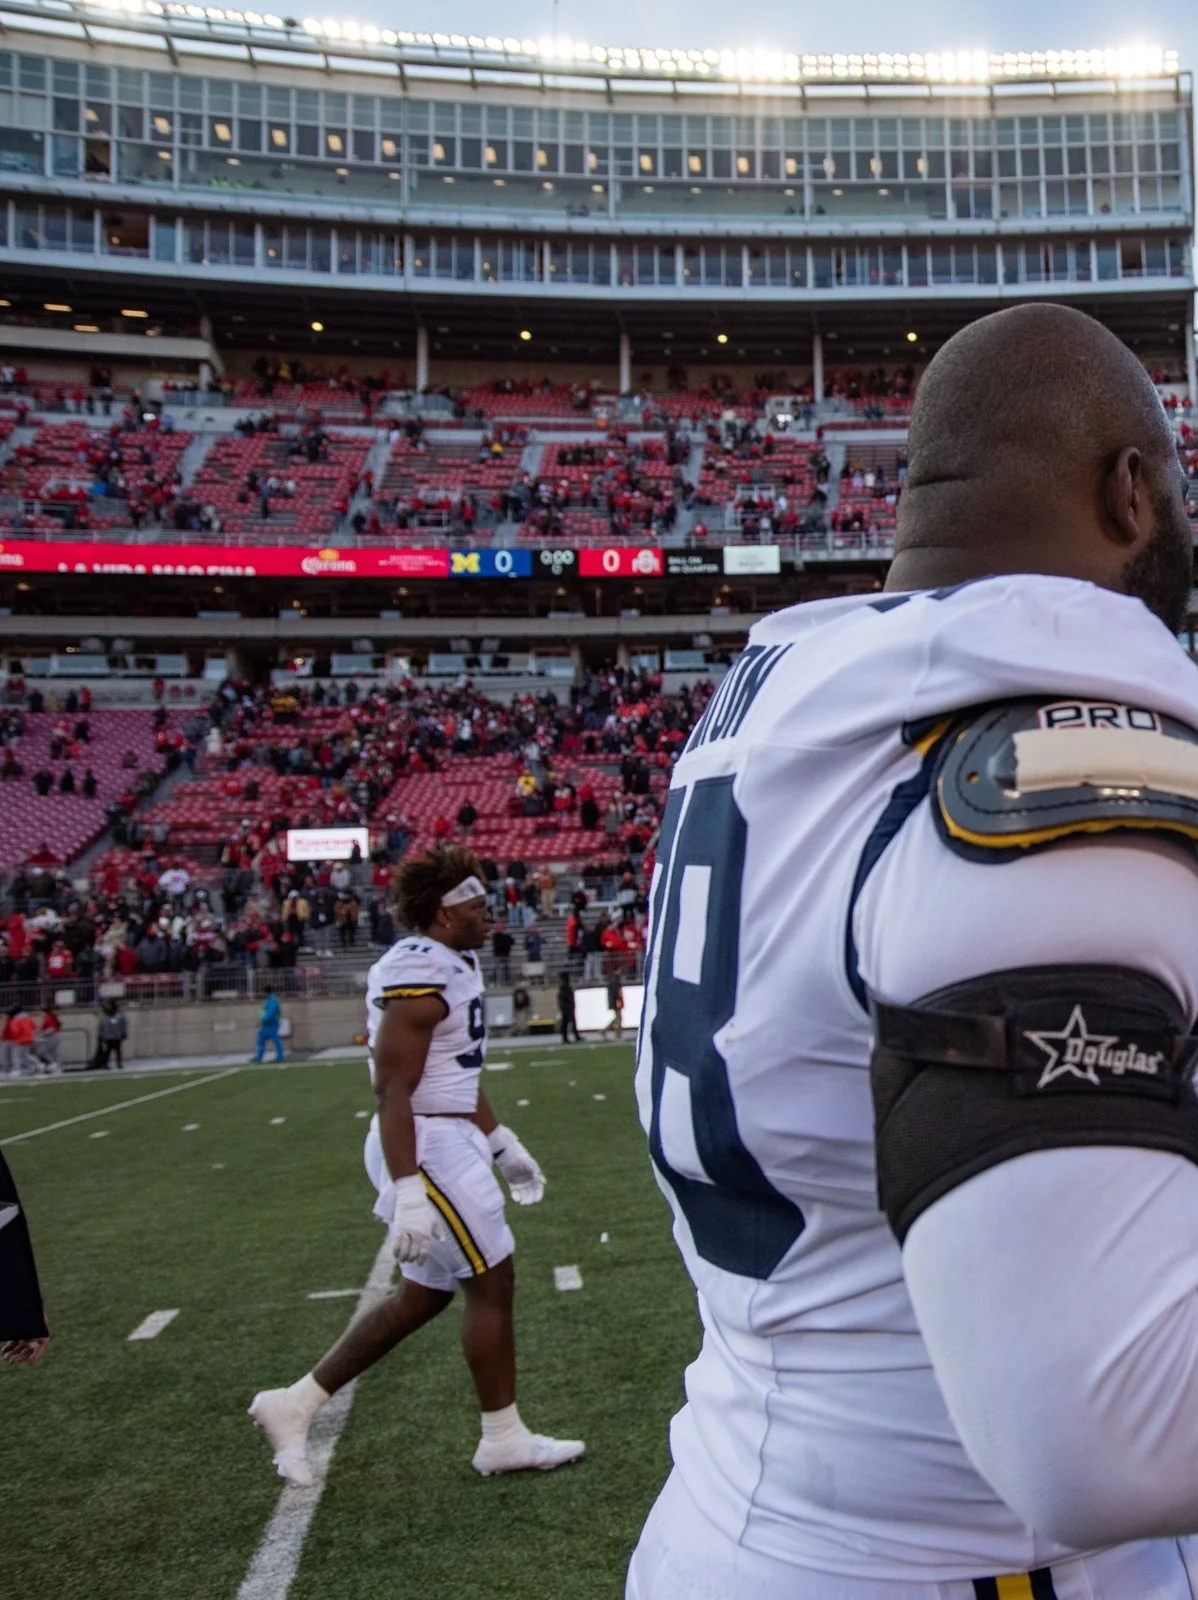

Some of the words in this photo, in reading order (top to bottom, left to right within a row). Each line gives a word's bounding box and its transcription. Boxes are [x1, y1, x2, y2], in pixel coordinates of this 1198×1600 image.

[301, 556, 356, 575] Corona
[451, 552, 480, 574] M
[495, 550, 513, 573] 0
[603, 549, 620, 572] 0
[1045, 704, 1158, 732] PRO
[1063, 1037, 1158, 1075] Douglas
